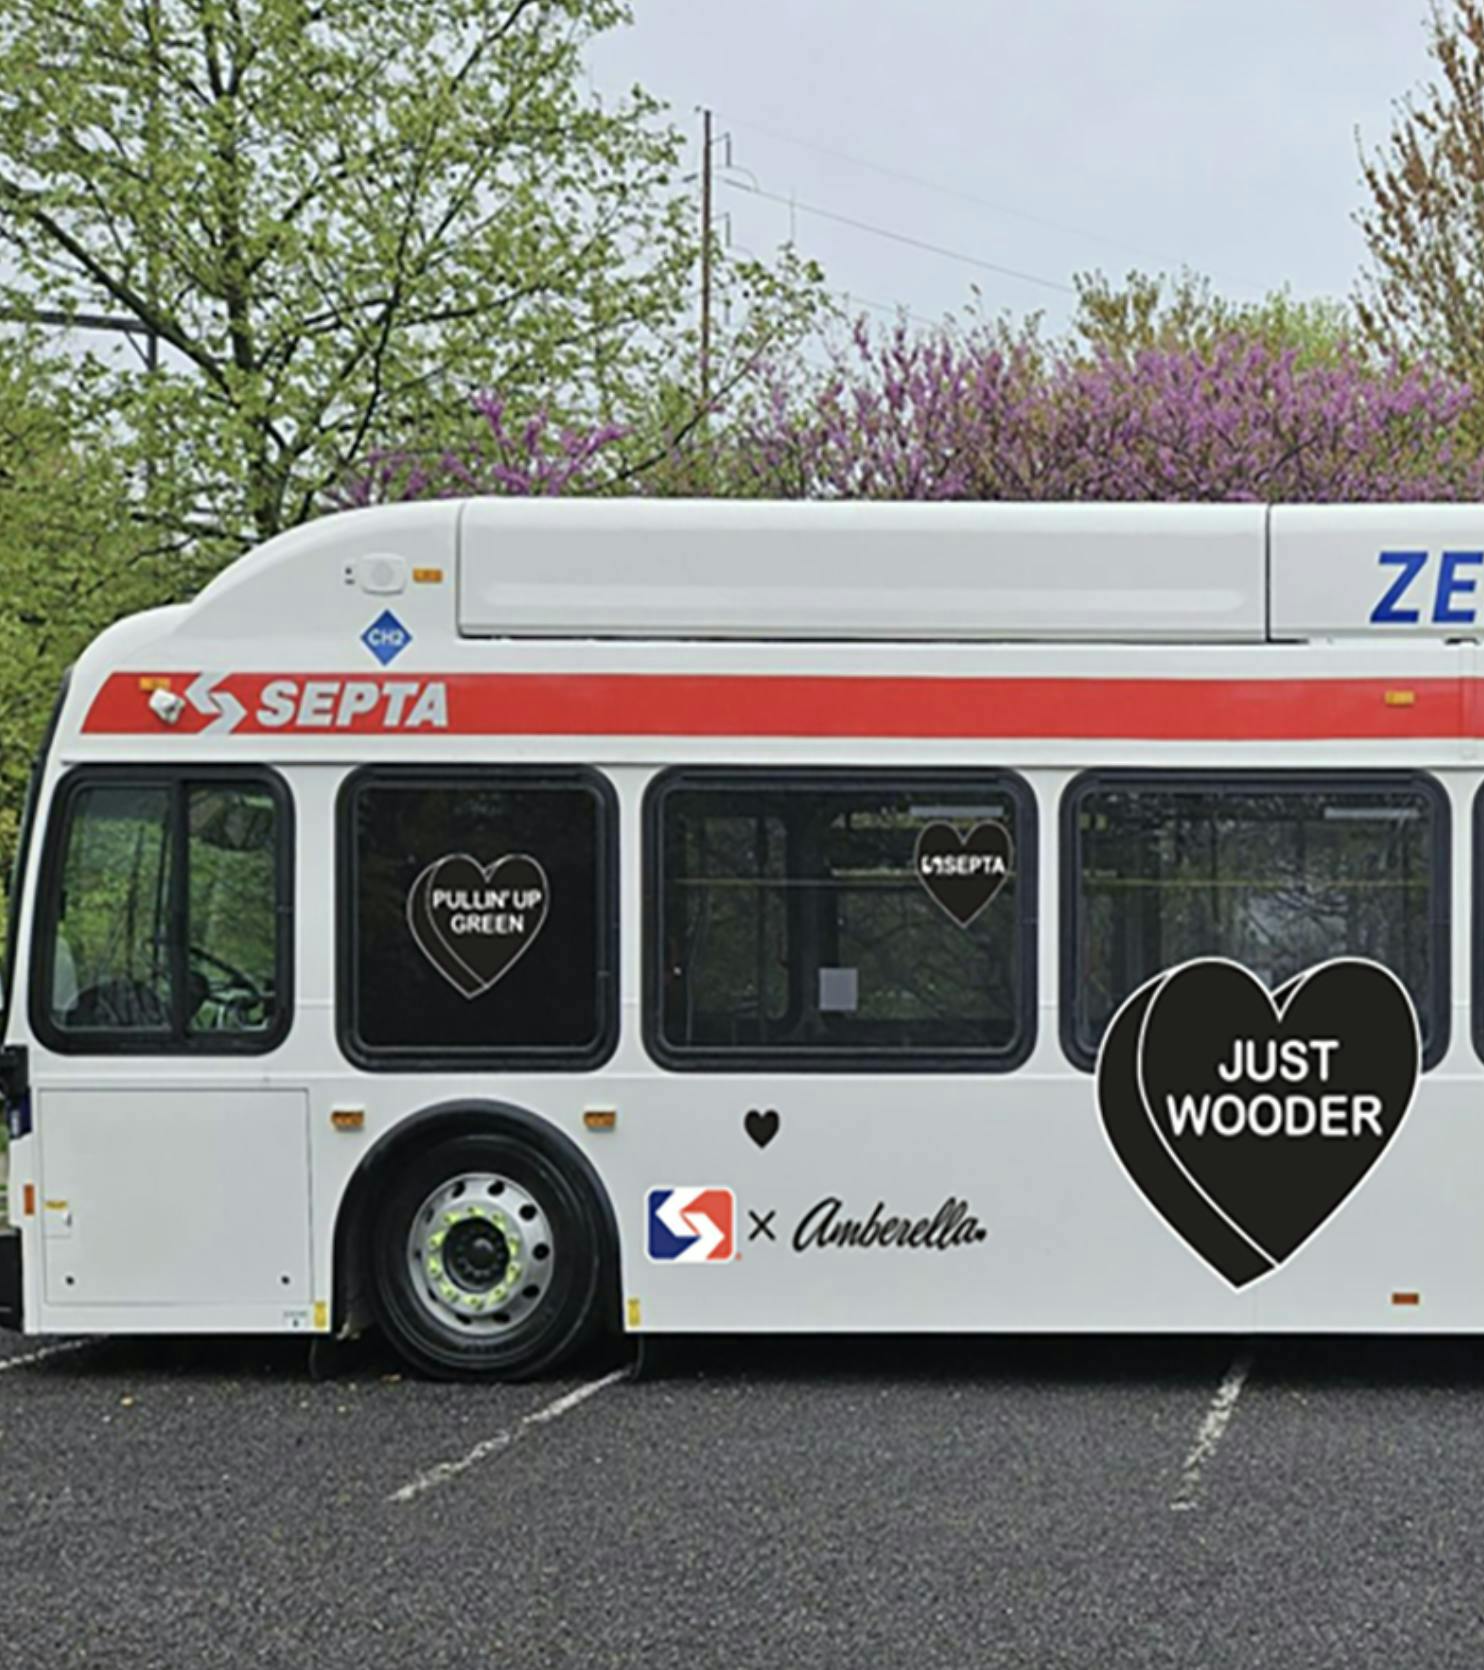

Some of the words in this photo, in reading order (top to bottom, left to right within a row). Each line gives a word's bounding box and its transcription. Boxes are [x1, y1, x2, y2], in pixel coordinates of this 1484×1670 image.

[368, 628, 405, 647] CH2
[256, 680, 449, 728] SEPTA
[944, 855, 1005, 874] SEPTA
[513, 890, 542, 909] UP
[450, 914, 524, 934] GREEN
[1218, 1039, 1339, 1083] JUST
[1166, 1095, 1384, 1138] WOODER
[793, 1197, 980, 1252] Amberella
